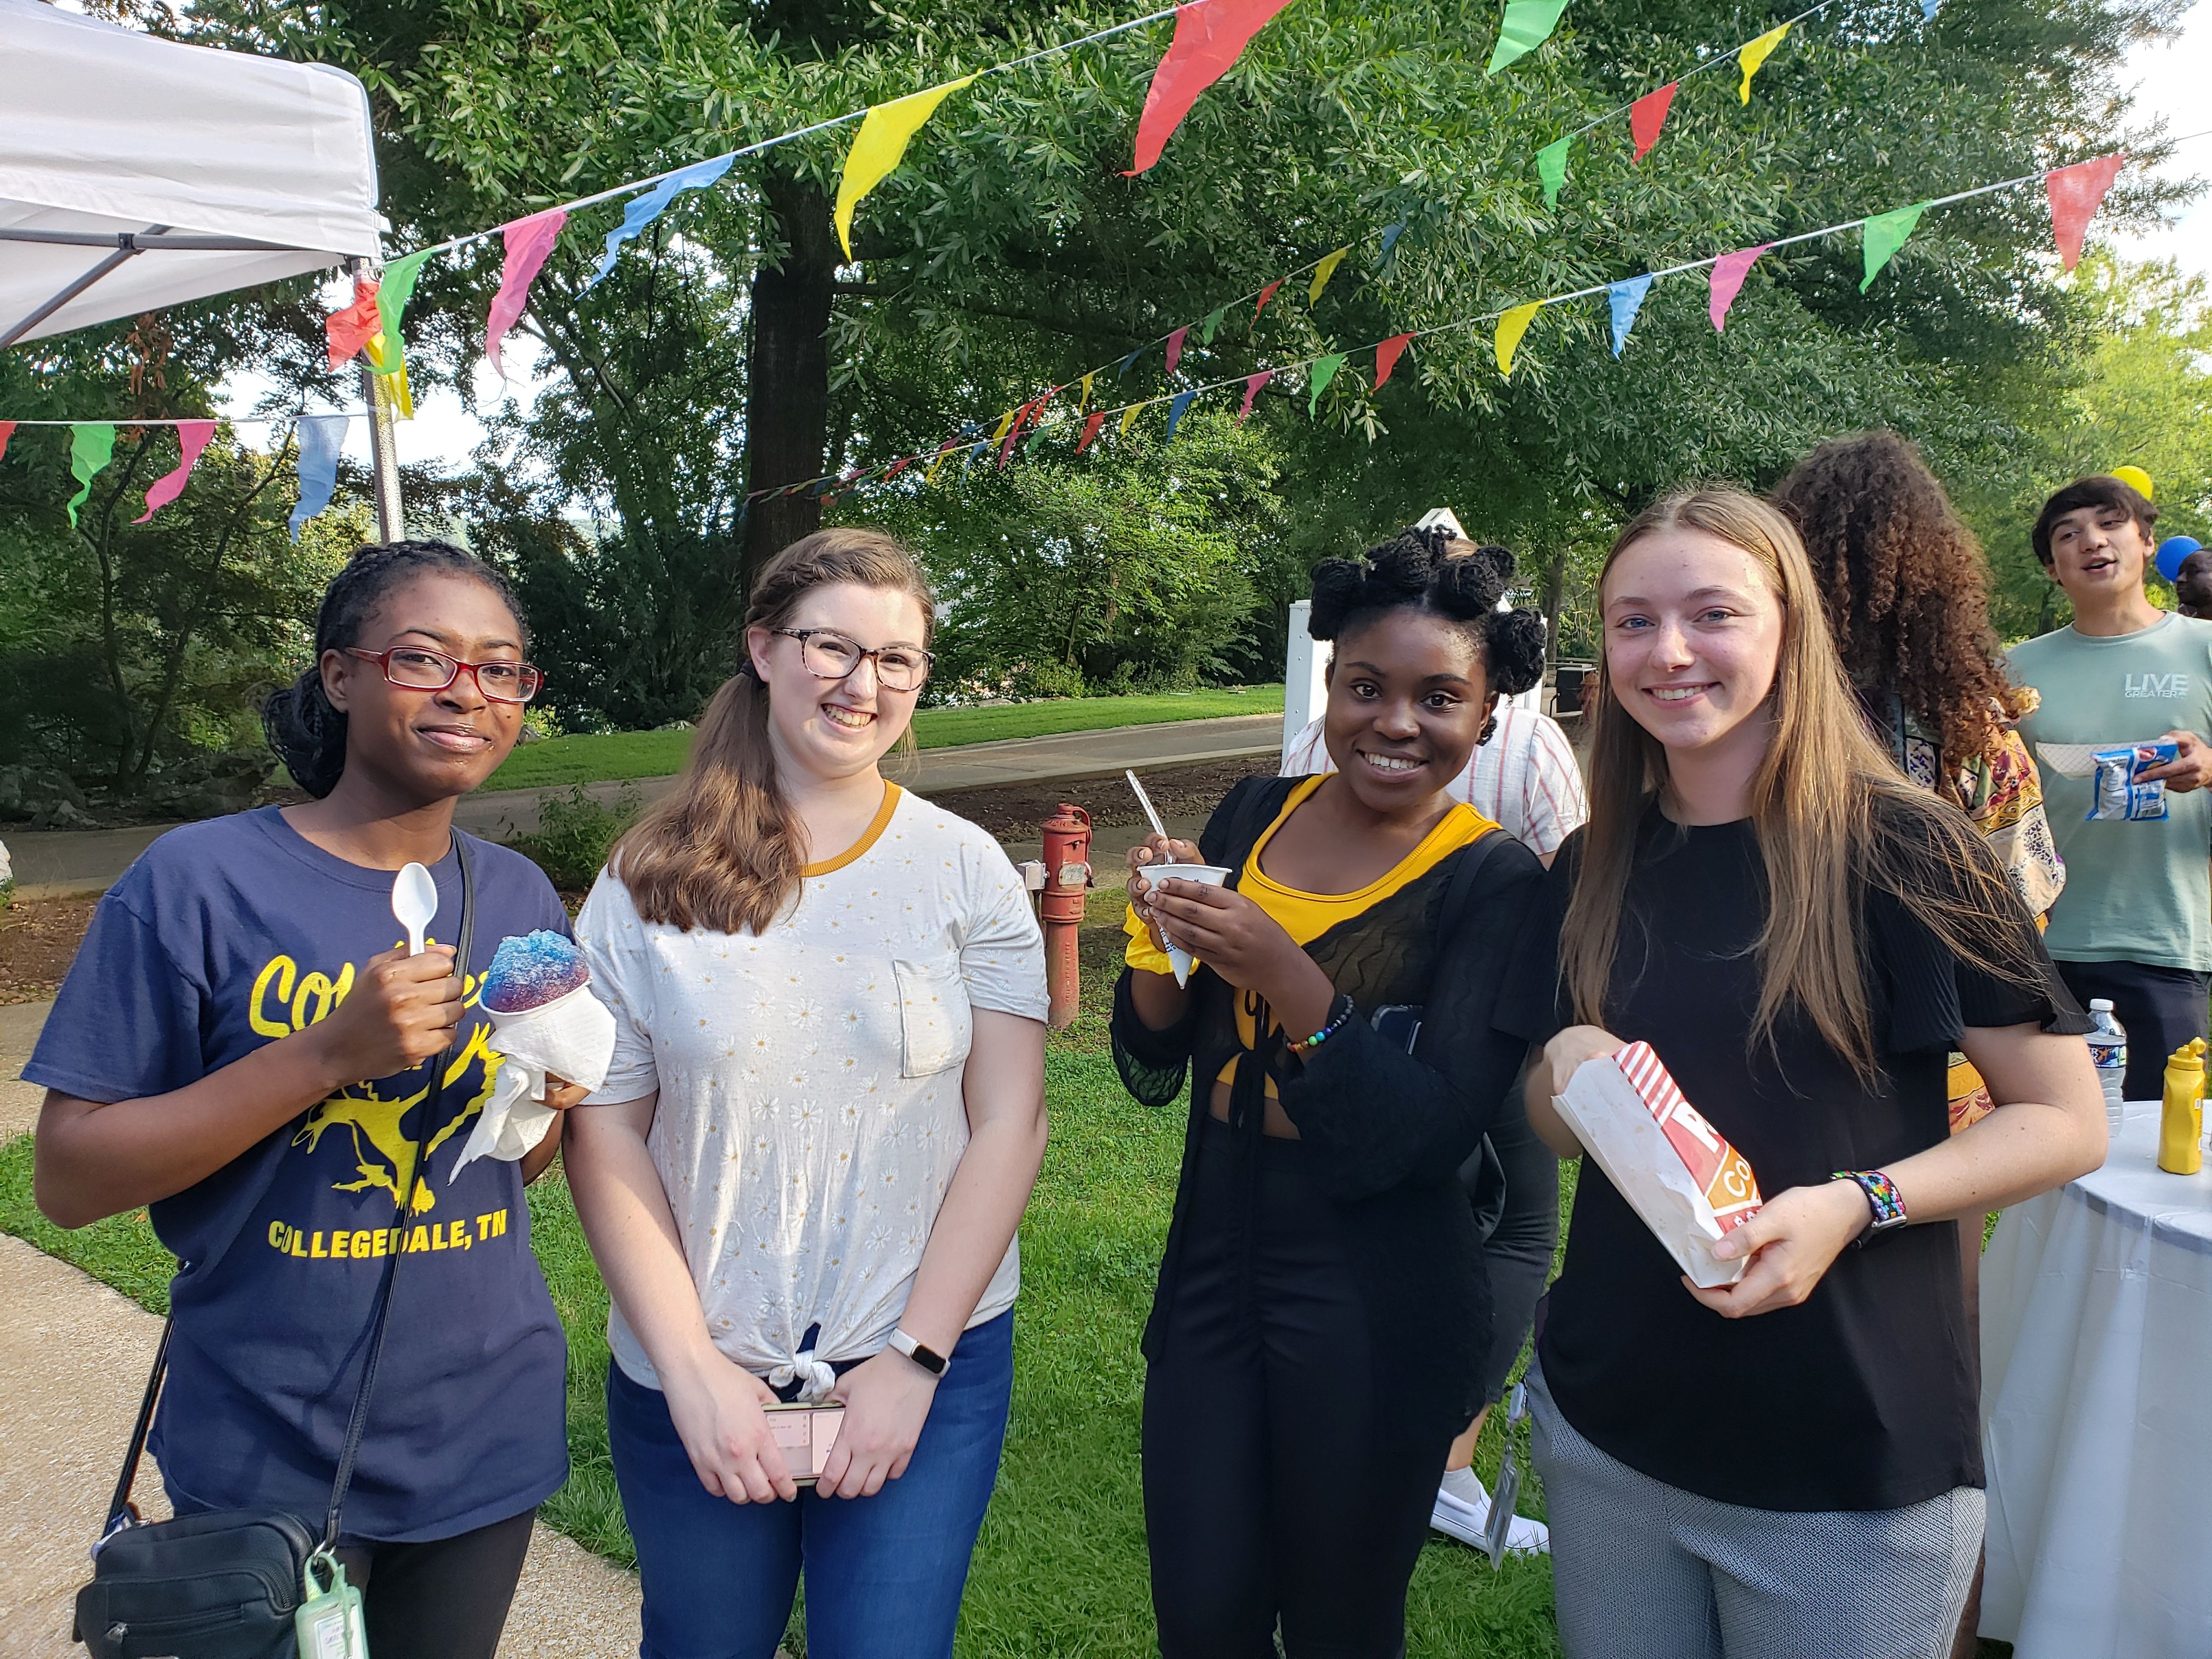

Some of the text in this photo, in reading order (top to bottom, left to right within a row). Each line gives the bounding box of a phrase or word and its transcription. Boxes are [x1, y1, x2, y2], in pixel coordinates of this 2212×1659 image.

[2125, 673, 2189, 691] LIVE
[2124, 690, 2177, 698] GREATER
[476, 1209, 507, 1241] TN
